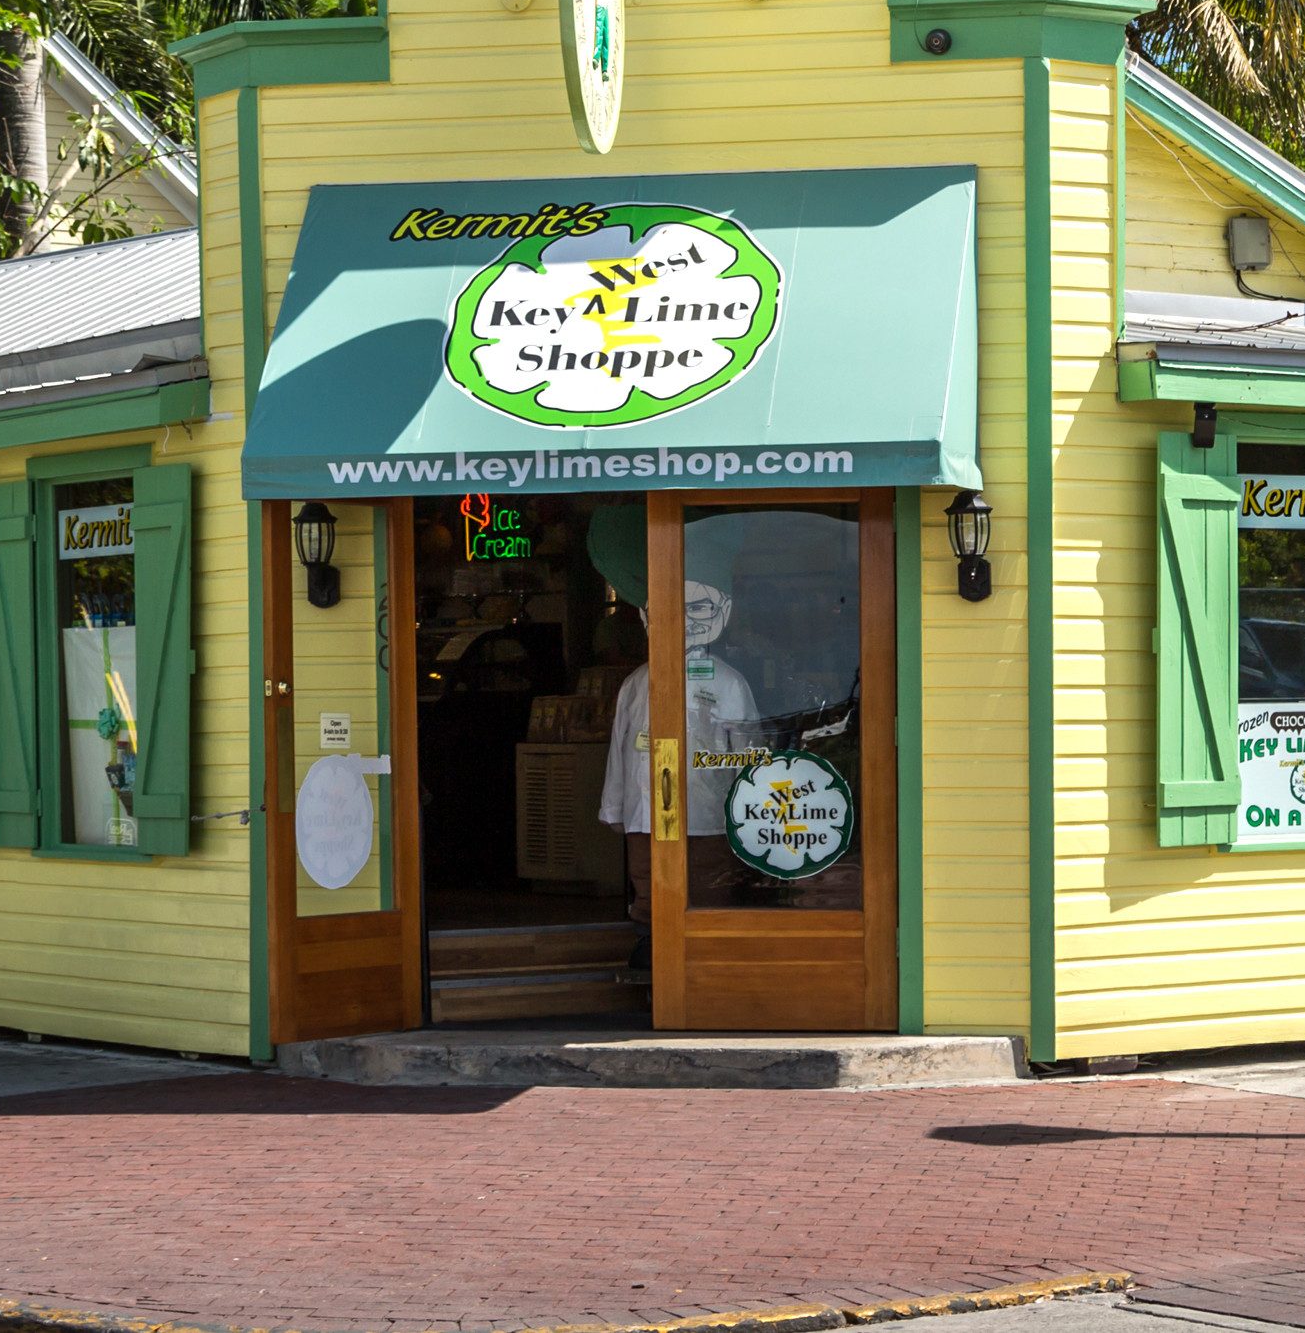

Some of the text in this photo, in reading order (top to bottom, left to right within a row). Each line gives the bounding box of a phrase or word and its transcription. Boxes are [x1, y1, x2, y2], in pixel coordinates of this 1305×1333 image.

[390, 203, 608, 241] Kermit's
[588, 242, 712, 292] West
[489, 296, 750, 333] Key Lime
[515, 344, 703, 377] Shoppe
[327, 447, 854, 487] www.keylimeshop.com
[63, 507, 134, 550] Kermit
[493, 504, 521, 531] Ice
[473, 533, 531, 559] Cream
[1237, 710, 1269, 734] rozen
[693, 748, 773, 768] Kermit's
[1239, 738, 1279, 763] KEY
[769, 779, 817, 805] West
[745, 803, 838, 824] Key Lime
[1246, 805, 1280, 827] ON
[1288, 809, 1301, 826] A
[757, 828, 828, 849] Shoppe
